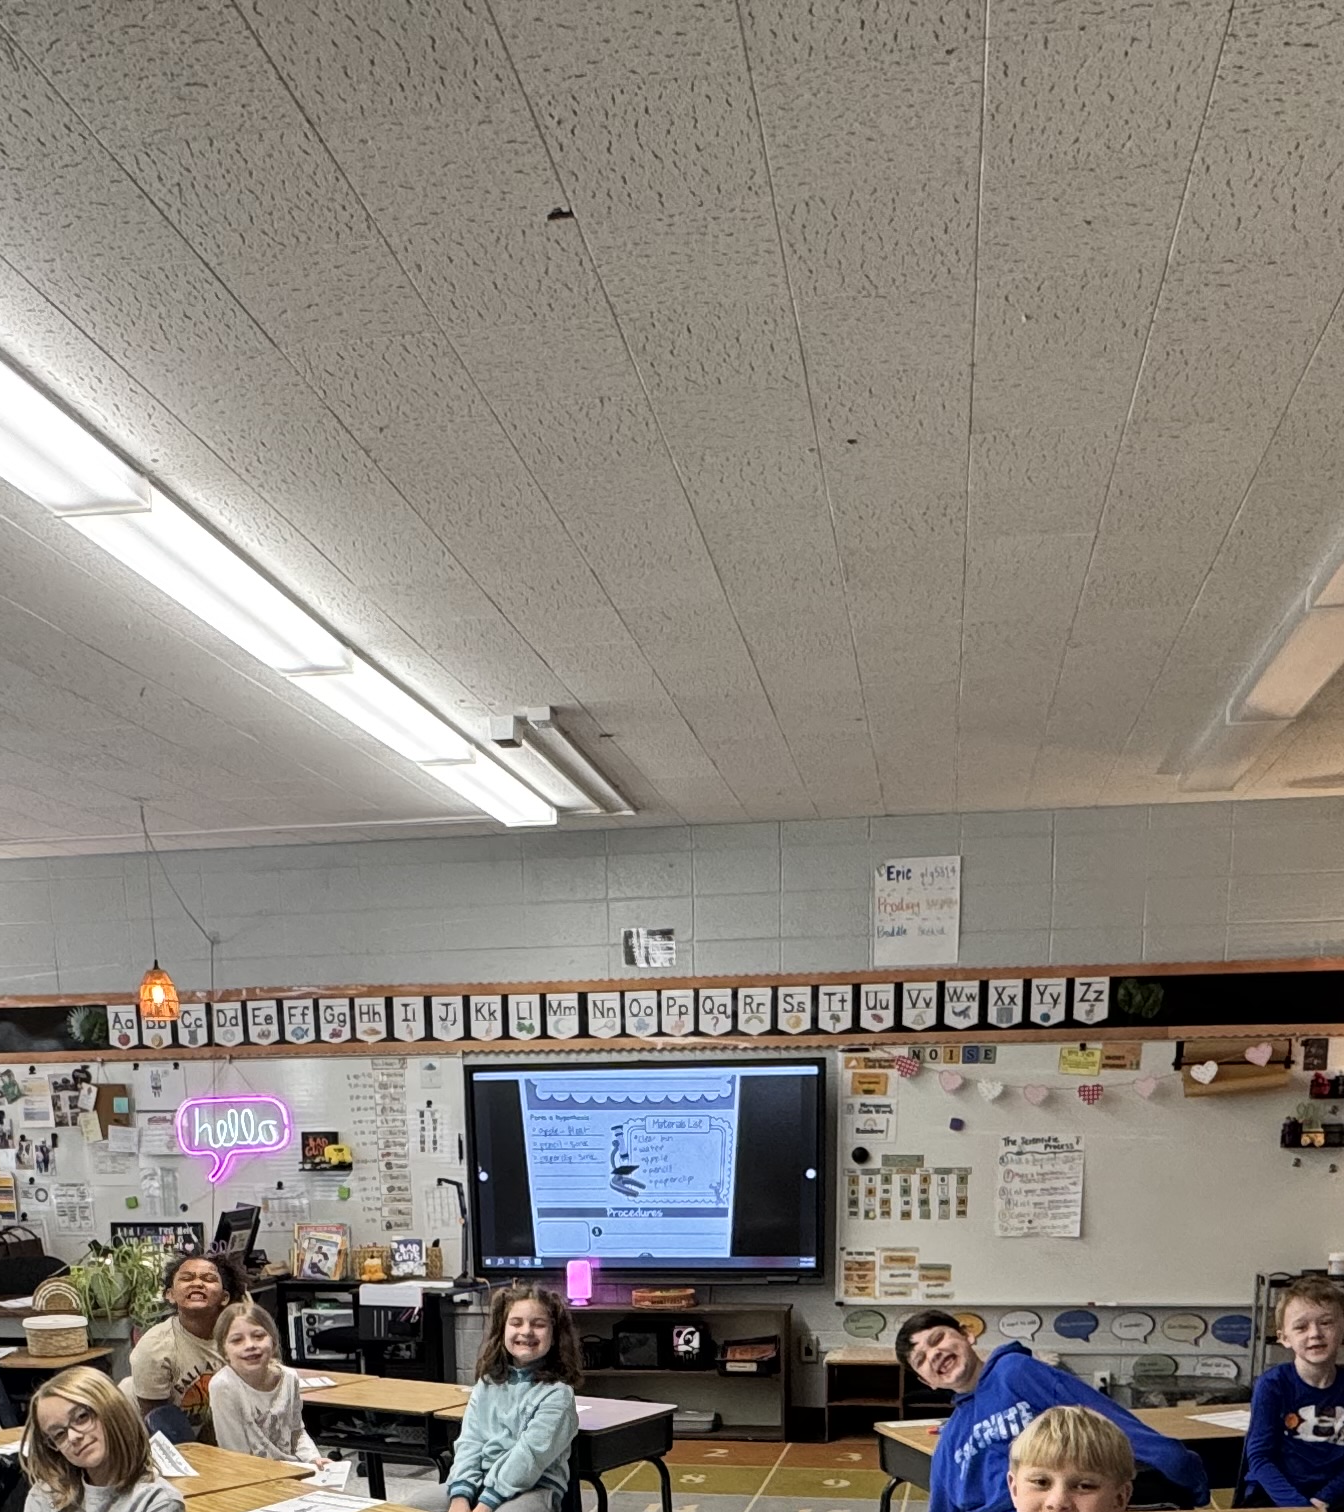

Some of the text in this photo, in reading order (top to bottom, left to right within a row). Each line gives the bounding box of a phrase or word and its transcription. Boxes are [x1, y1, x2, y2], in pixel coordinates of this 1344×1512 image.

[886, 865, 912, 883] Epic
[112, 1012, 134, 1030] Aa
[180, 1010, 203, 1028] Cc
[216, 1008, 239, 1027] Dd
[251, 1007, 274, 1025] Ee
[287, 1006, 310, 1024] Ff
[323, 1005, 347, 1026] Gg
[359, 1004, 383, 1023] Hh
[400, 1004, 417, 1023] Ii
[438, 1003, 457, 1027] Jj
[474, 1002, 497, 1021] Kk
[516, 1002, 532, 1020] Ll
[548, 1000, 577, 1016] Mm
[592, 1000, 617, 1019] Nn
[628, 998, 654, 1017] Oo
[666, 997, 690, 1020] Pp
[702, 996, 730, 1019] Qq
[742, 995, 766, 1014] Rr
[782, 994, 807, 1014] Ss
[823, 992, 849, 1012] Tt
[865, 990, 891, 1010] Uu
[907, 989, 933, 1009] Vv
[946, 986, 977, 1003] Ww
[993, 985, 1018, 1007] Xx
[1035, 984, 1061, 1009] Yy
[1079, 982, 1106, 1003] Zz
[912, 1049, 993, 1061] NOISE
[194, 1107, 280, 1149] hello
[652, 1118, 703, 1129] Materials List
[1002, 1135, 1060, 1147] The Scientific
[648, 1164, 673, 1175] pencil
[653, 1175, 695, 1188] paperclip
[606, 1208, 663, 1218] Procedures
[398, 1243, 421, 1253] BAD
[394, 1252, 421, 1262] GUYS
[704, 1448, 729, 1458] 2
[835, 1452, 863, 1462] 3
[679, 1472, 706, 1484] 8
[822, 1478, 851, 1489] 9
